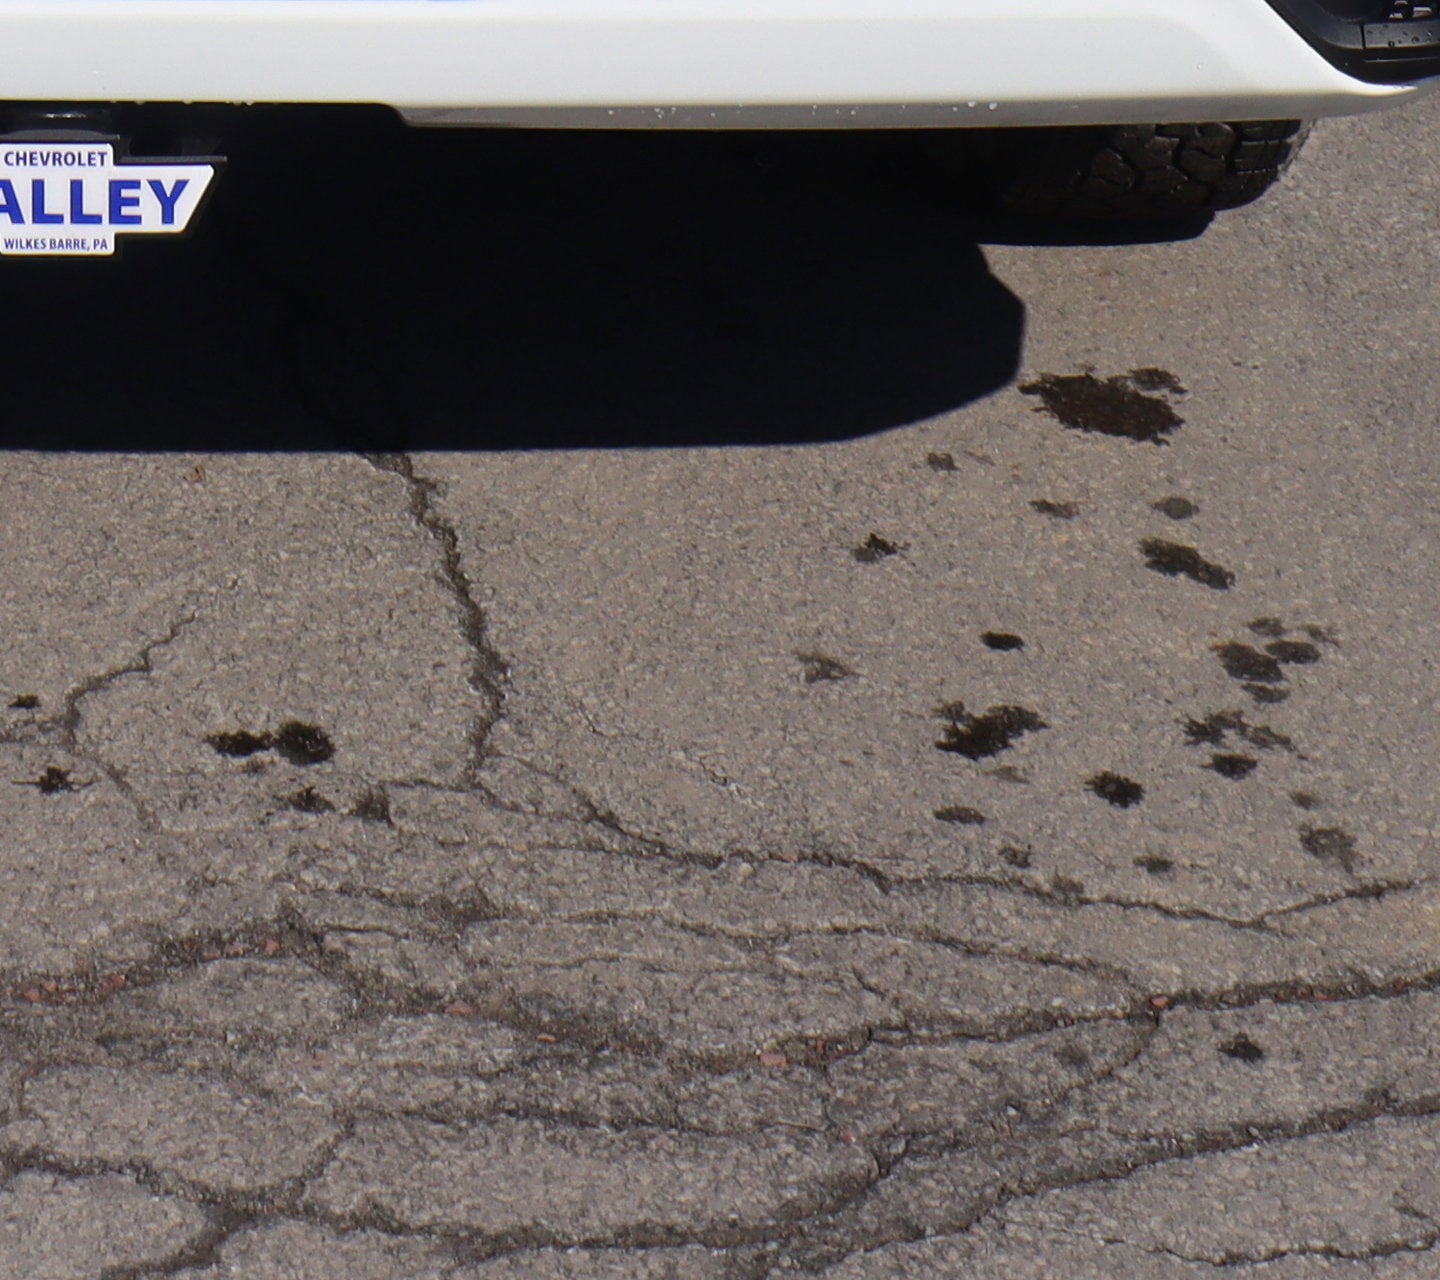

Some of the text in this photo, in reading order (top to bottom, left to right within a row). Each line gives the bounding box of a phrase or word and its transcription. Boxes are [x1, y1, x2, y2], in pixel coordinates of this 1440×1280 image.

[3, 151, 108, 167] CHEVROLET
[4, 238, 108, 252] WILKES BARRE, PA
